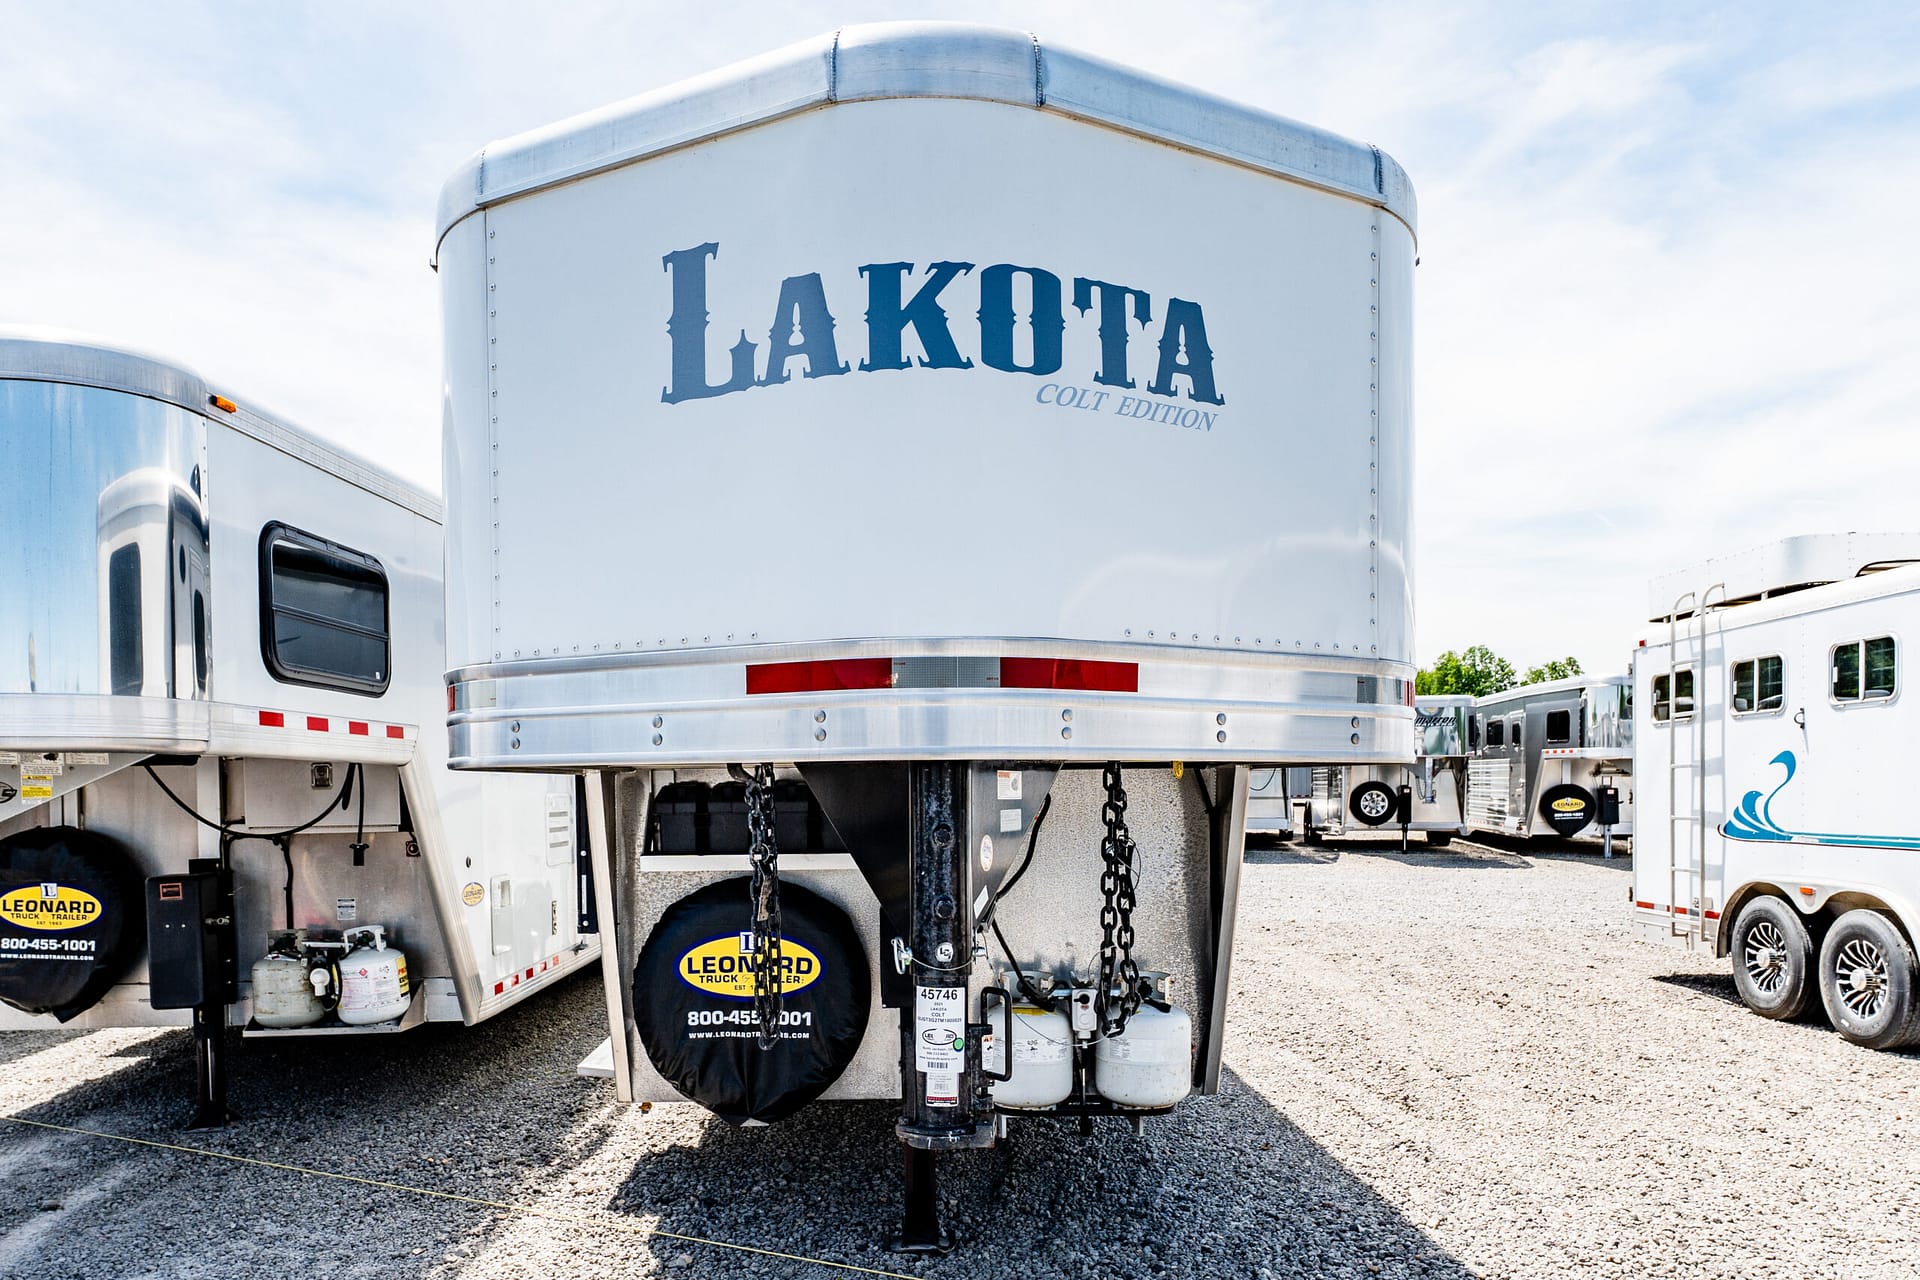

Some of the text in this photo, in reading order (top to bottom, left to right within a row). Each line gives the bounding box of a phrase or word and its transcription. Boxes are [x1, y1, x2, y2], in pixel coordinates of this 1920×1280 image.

[661, 242, 1225, 406] LAKOTA
[1036, 383, 1219, 432] COLT EDITION
[2, 899, 96, 914] LEONARD
[1, 938, 96, 951] 800-455-1001
[687, 956, 813, 975] LEONRD
[699, 974, 738, 983] TRUCK
[921, 988, 958, 1000] 45746
